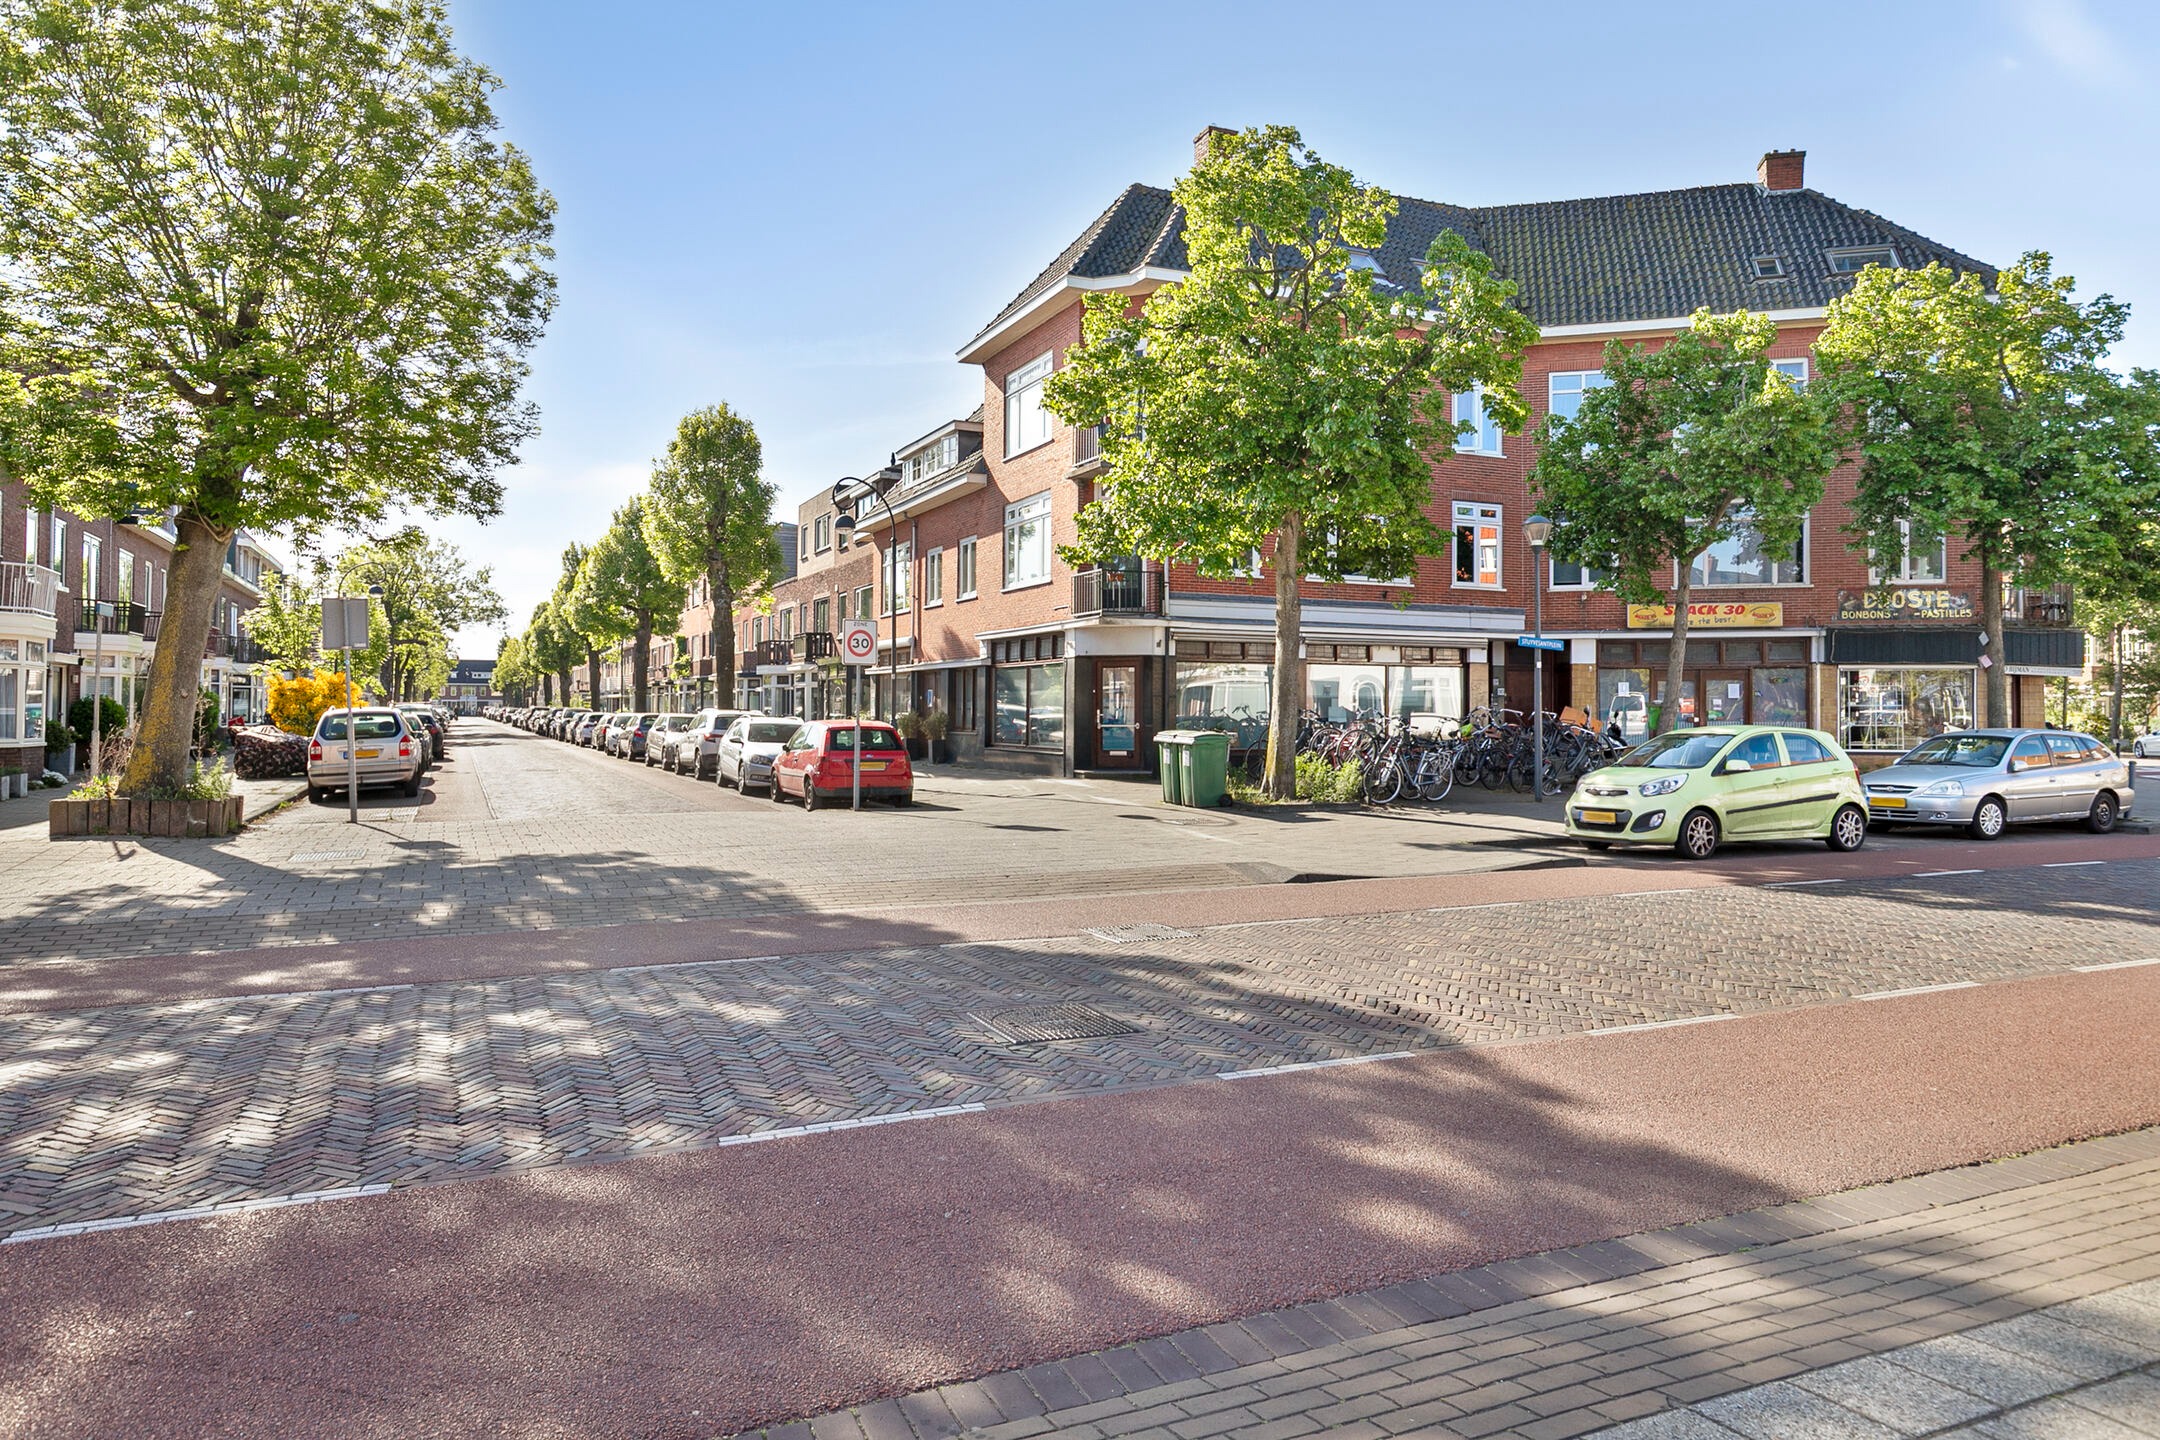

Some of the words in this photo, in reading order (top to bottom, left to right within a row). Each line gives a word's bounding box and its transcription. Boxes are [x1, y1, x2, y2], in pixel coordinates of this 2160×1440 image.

[1664, 604, 1718, 616] SACK
[1723, 604, 1745, 615] 30
[852, 638, 869, 649] 30
